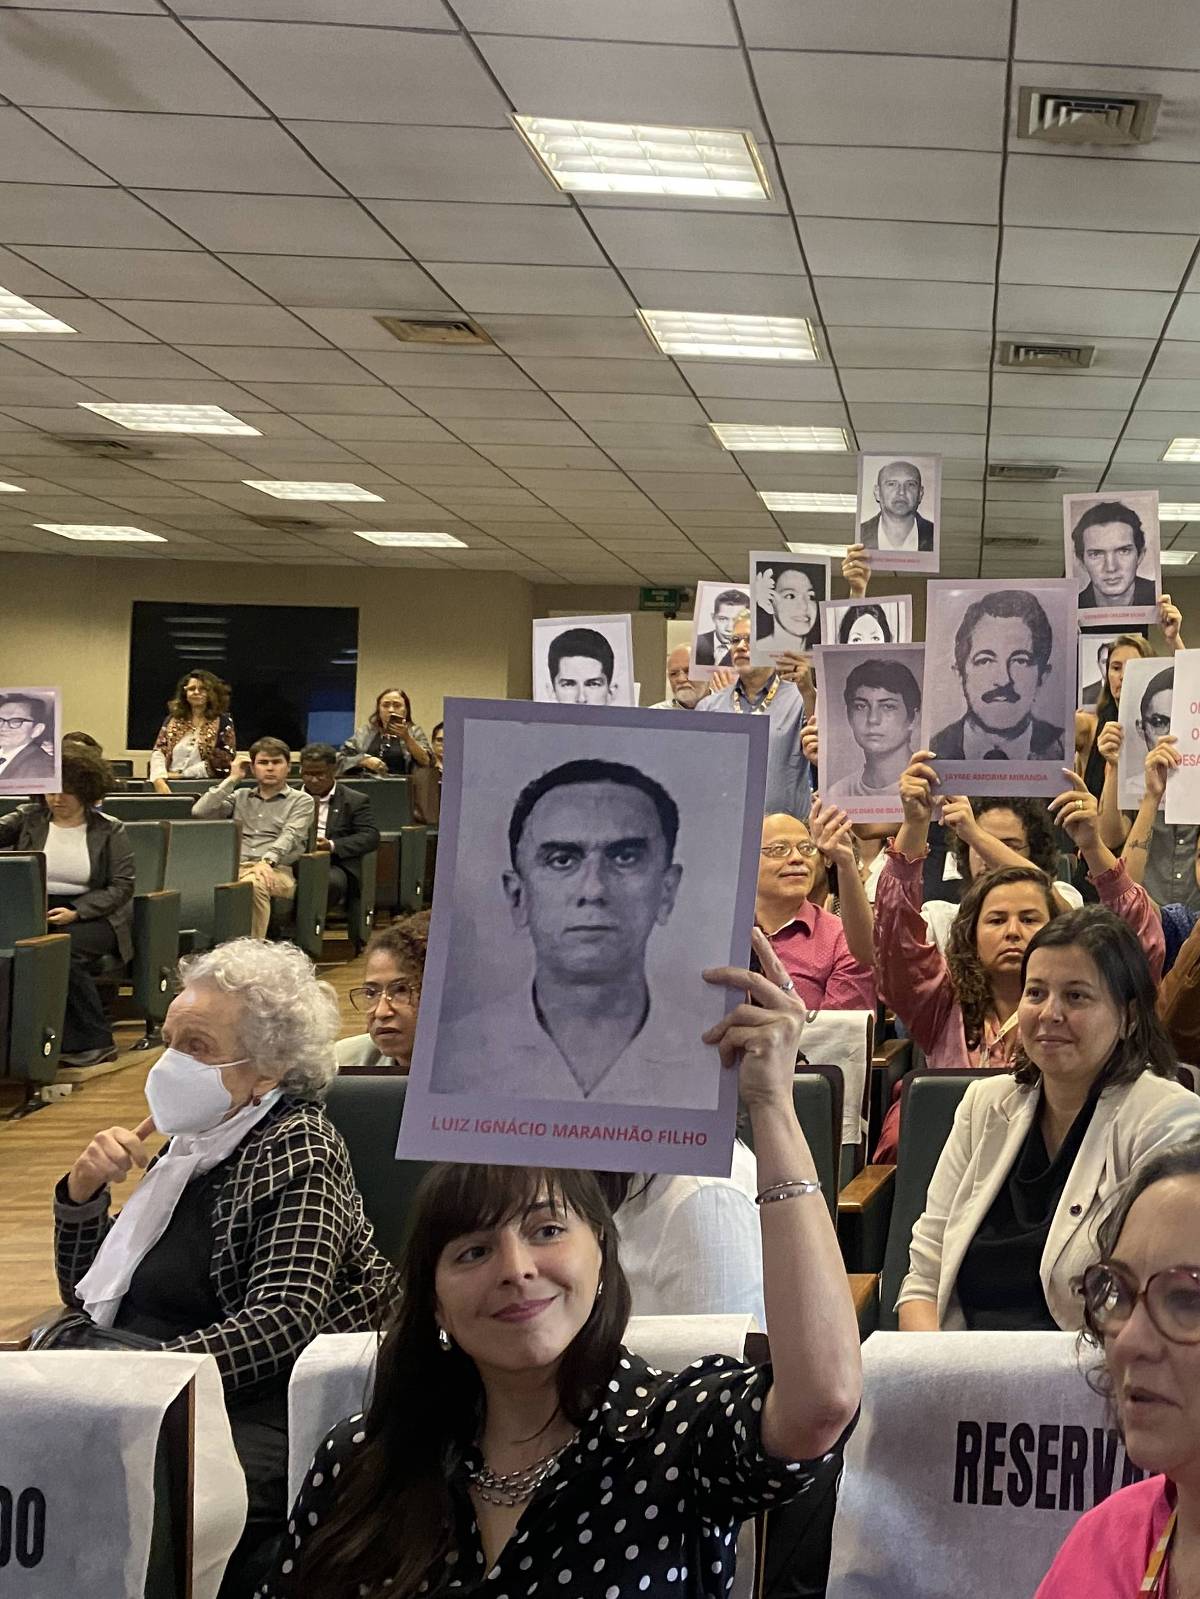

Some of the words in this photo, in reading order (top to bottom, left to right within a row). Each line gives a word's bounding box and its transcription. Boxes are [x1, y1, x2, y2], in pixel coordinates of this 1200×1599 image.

[1009, 774, 1048, 782] MIRANDA
[431, 1116, 469, 1132] LUIZ
[474, 1117, 547, 1137] IGNÁCIO
[552, 1124, 653, 1143] MARANHÃO
[657, 1130, 708, 1147] FILHO
